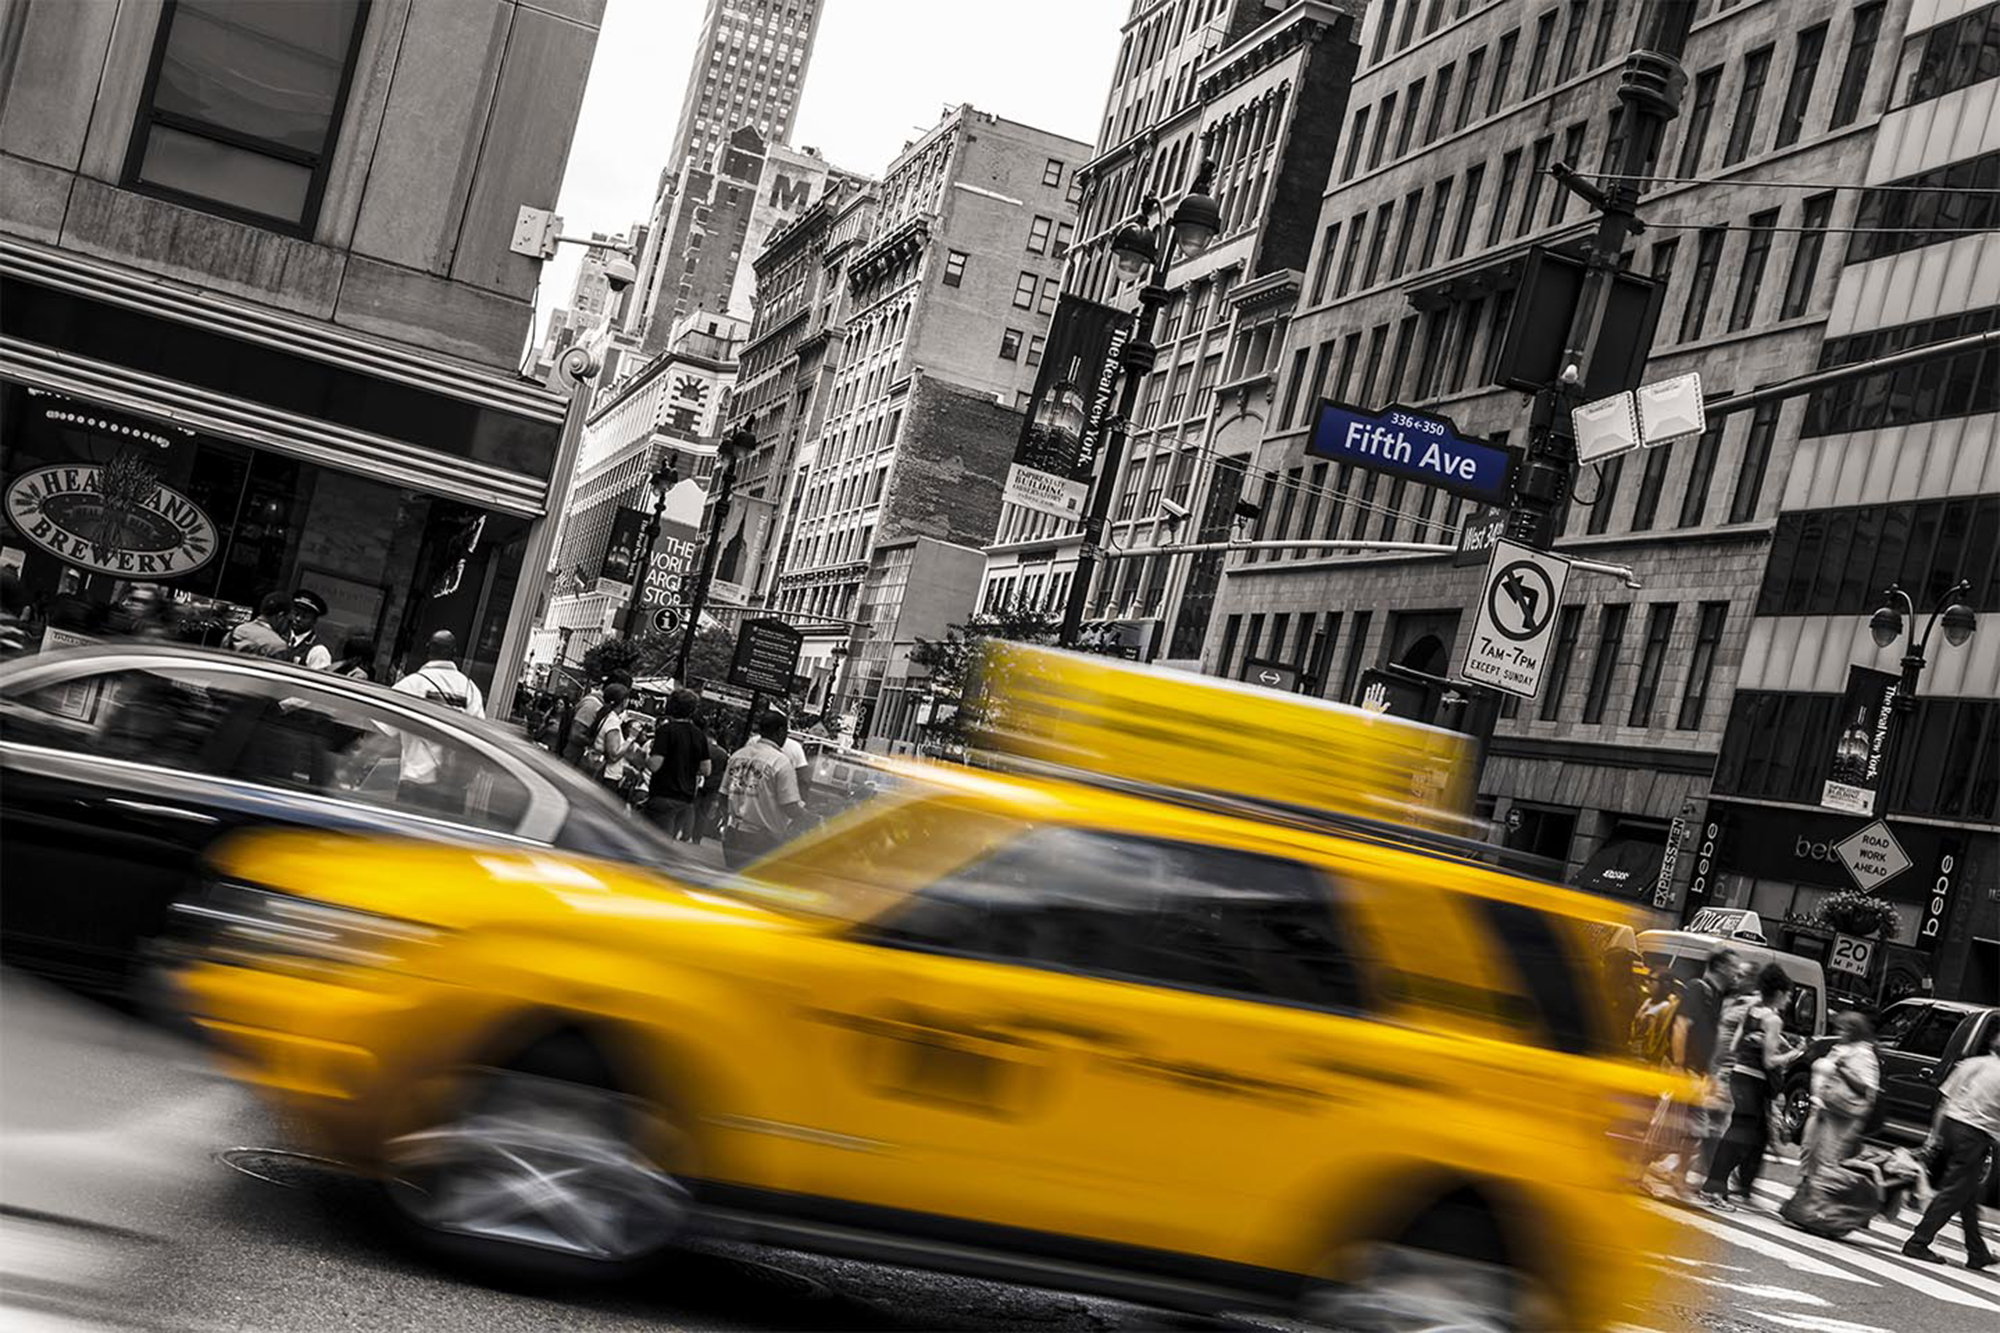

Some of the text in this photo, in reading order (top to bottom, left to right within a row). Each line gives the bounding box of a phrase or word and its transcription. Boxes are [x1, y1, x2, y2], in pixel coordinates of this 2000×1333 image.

[1077, 329, 1129, 467] The Real New York.
[1391, 412, 1445, 436] 336 350
[1344, 421, 1477, 480] Fifth Ave
[41, 469, 200, 529] HEAAND
[1015, 475, 1064, 497] BUILDING
[29, 516, 176, 573] BREWERY
[666, 535, 697, 560] THE
[1462, 524, 1487, 551] West
[643, 586, 682, 606] STOR
[1481, 636, 1537, 670] 7AM-7PM
[1470, 658, 1534, 687] EXCEPT SUNDAY
[1865, 685, 1897, 780] The Real New York.
[1795, 835, 1839, 863] beb
[1859, 848, 1887, 863] WORK
[1861, 834, 1890, 850] ROAD
[1654, 817, 1685, 908] EXPRESS MEN
[1691, 822, 1719, 894] bebe
[1853, 862, 1888, 877] AHEAD
[1922, 854, 1954, 938] bebe
[1836, 939, 1868, 962] 20
